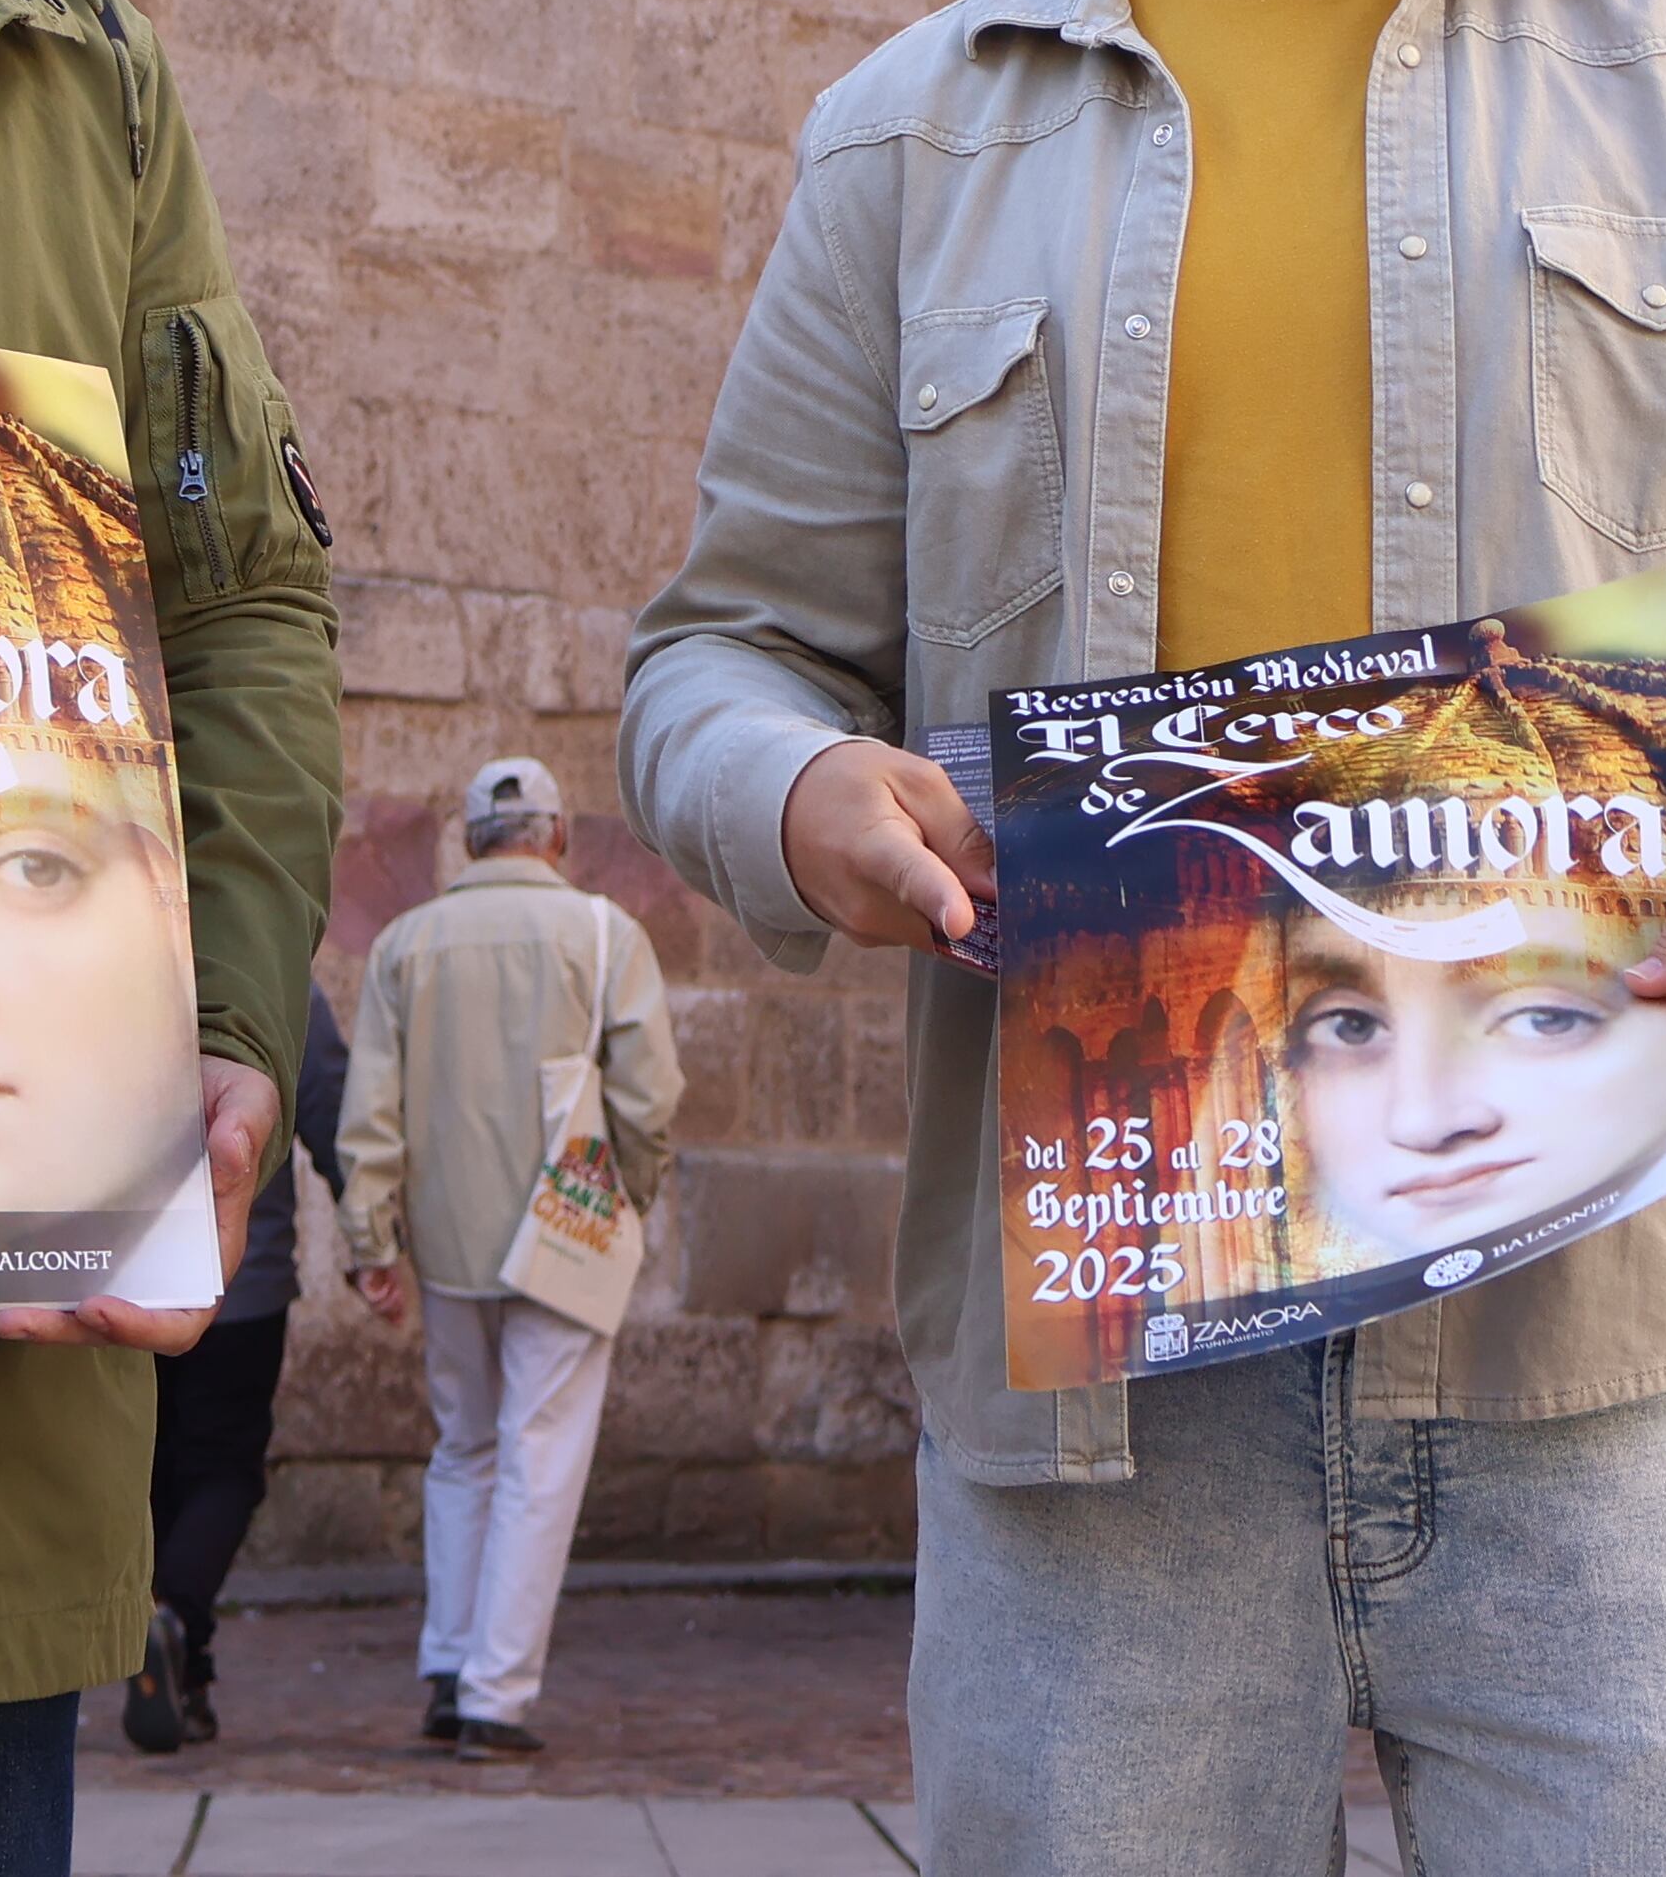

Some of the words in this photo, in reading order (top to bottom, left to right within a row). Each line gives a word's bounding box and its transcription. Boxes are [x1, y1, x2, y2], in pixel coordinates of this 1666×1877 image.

[1006, 672, 1235, 717] Recreación
[1244, 633, 1438, 693] Medieval
[1016, 714, 1127, 763] El
[1151, 703, 1404, 749] Cerco
[1080, 782, 1146, 816] de
[1025, 1135, 1066, 1170] del
[1085, 1117, 1152, 1170] 25
[1171, 1140, 1201, 1170] al
[1219, 1119, 1281, 1167] 28
[1026, 1178, 1286, 1243] Septiembre
[1032, 1243, 1184, 1302] 2025
[1192, 1329, 1274, 1351] AYUNTAMIENTO
[1193, 1301, 1322, 1342] ZAMORA
